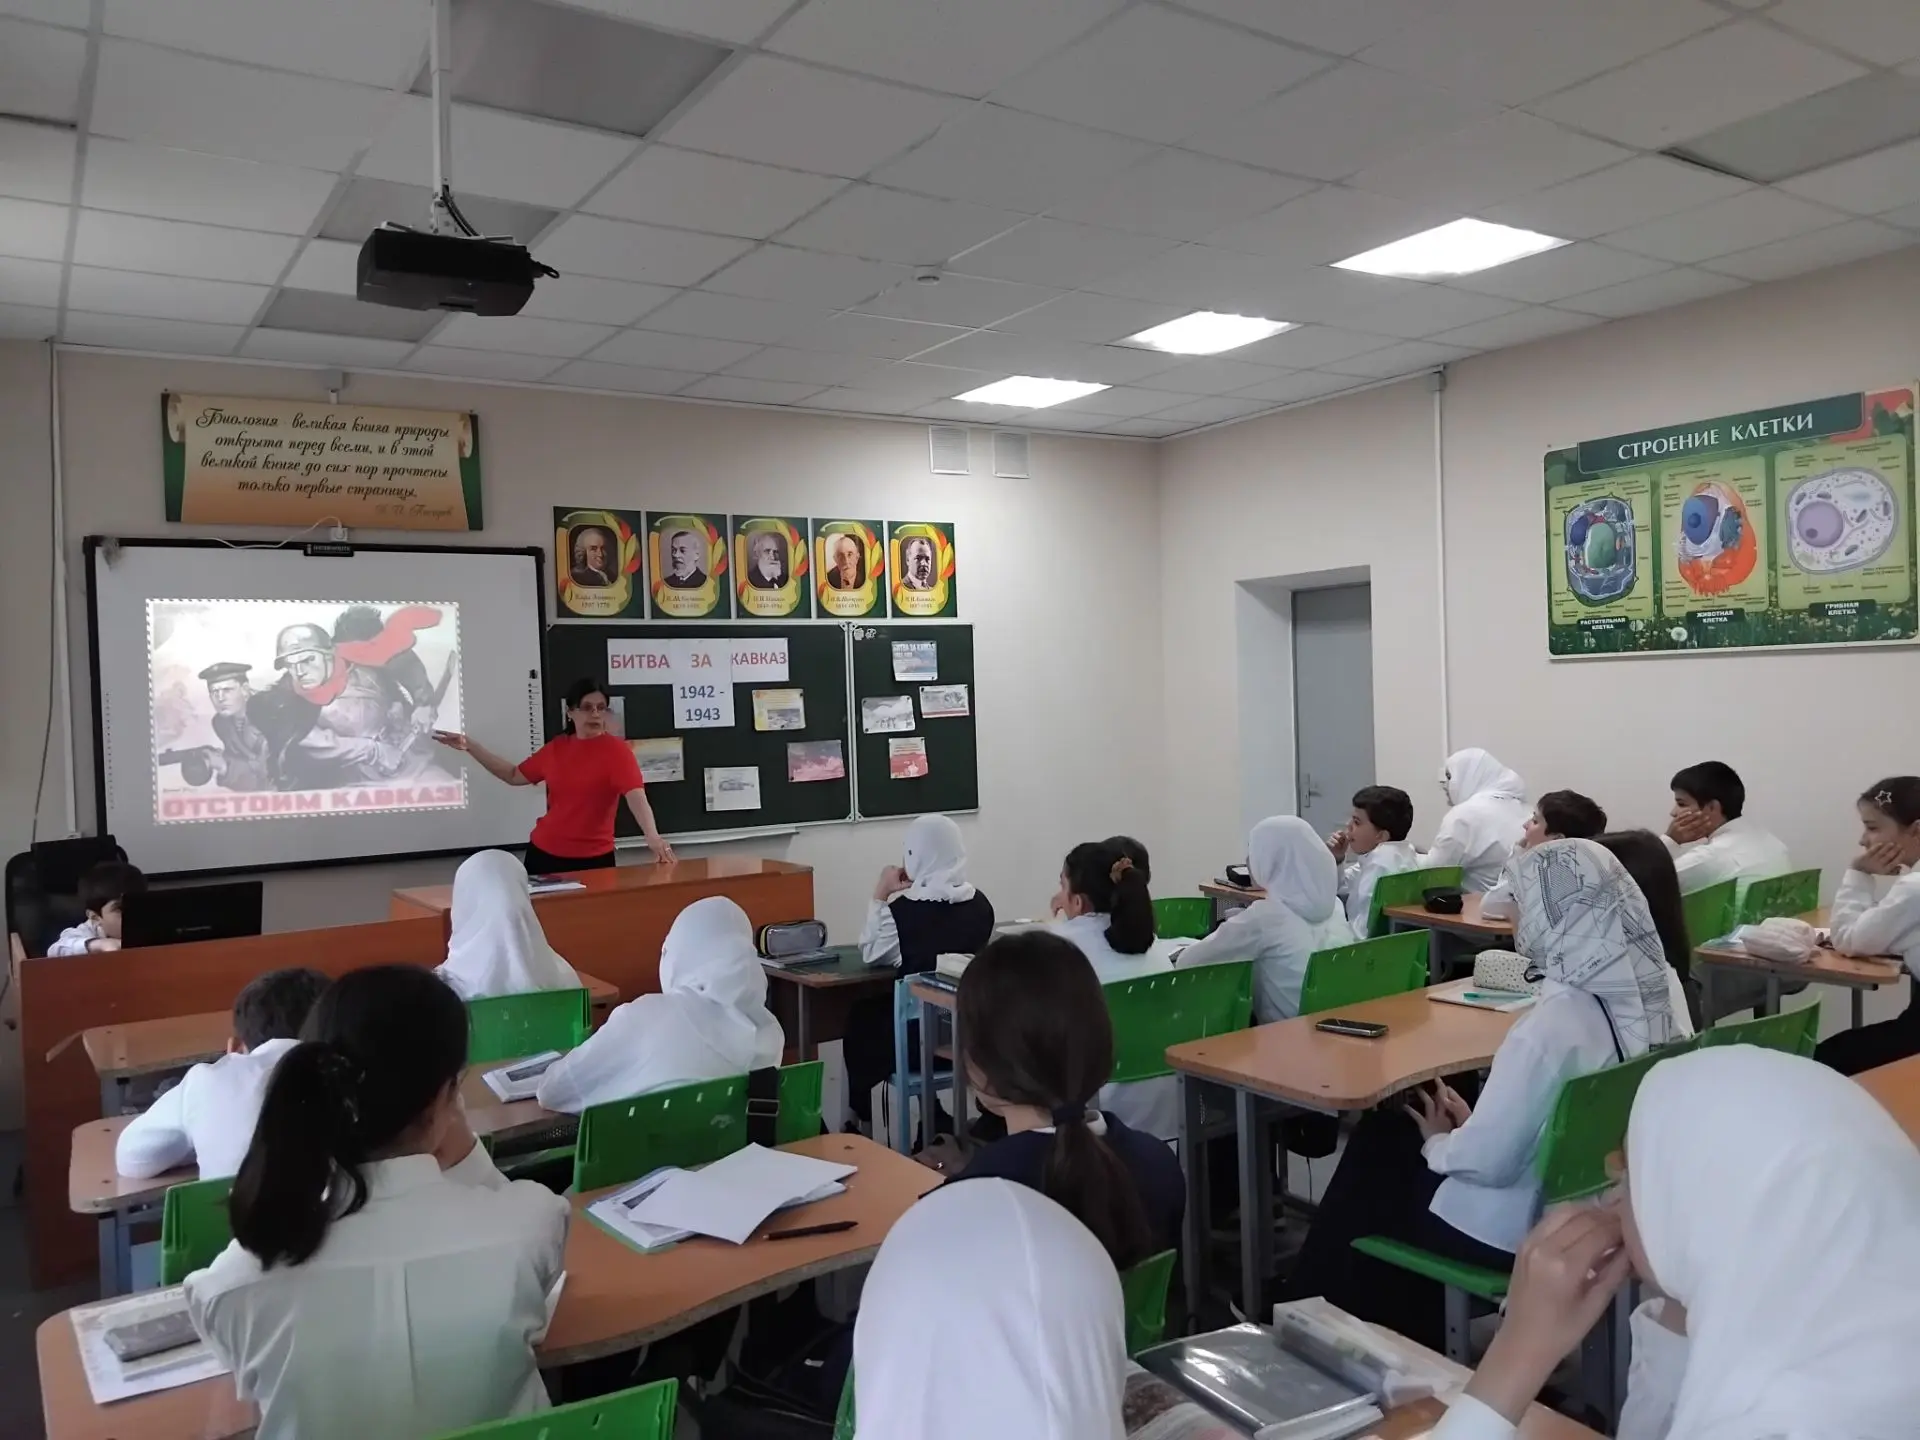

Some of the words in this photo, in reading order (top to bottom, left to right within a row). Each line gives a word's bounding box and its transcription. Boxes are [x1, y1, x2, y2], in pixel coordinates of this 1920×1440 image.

[196, 408, 278, 428] Биология
[292, 412, 347, 431] великая
[352, 416, 390, 434] книга
[395, 426, 450, 442] природы
[1618, 428, 1719, 460] СТРОЕНИЕ
[1731, 413, 1813, 442] КЛЕТКИ
[215, 430, 283, 455] открыта
[288, 439, 326, 456] перед
[378, 445, 386, 454] и
[390, 439, 401, 455] в
[402, 444, 434, 457] этой
[201, 450, 257, 469] великой
[262, 453, 301, 470] книге
[301, 462, 321, 476] до
[325, 463, 351, 473] сих
[355, 465, 378, 480] пор
[383, 466, 448, 481] прочтены
[238, 476, 290, 492] только
[295, 477, 342, 499] первые
[1696, 610, 1734, 618] ЖИВОТНАЯ
[611, 654, 670, 669] БИТВА
[691, 653, 712, 668] ЗА
[731, 652, 787, 665] КАВКАЗ
[680, 685, 715, 699] 1942
[686, 708, 720, 722] 1943
[163, 792, 321, 817] ОТСТОИМ
